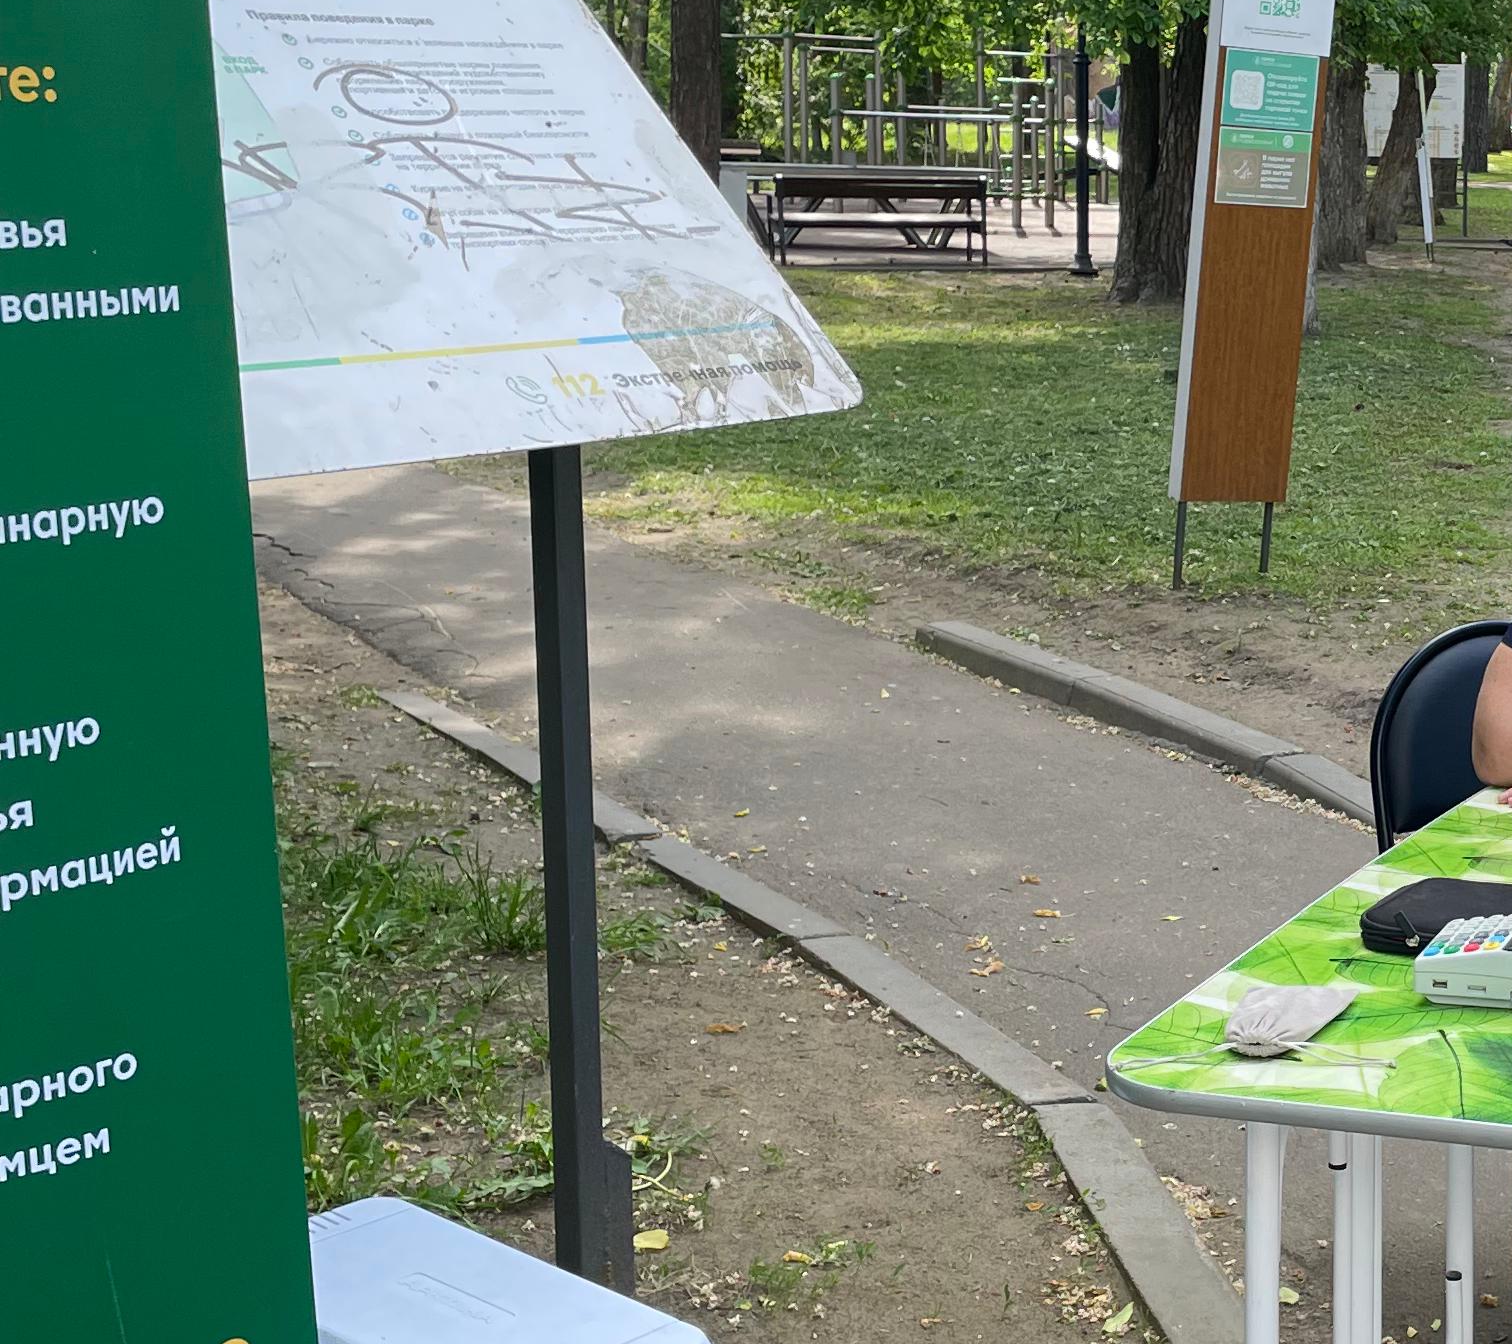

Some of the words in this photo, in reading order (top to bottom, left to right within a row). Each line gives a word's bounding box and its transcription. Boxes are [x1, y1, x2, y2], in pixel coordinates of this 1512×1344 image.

[0, 218, 67, 249] вья
[0, 285, 180, 324] ванными
[552, 373, 606, 399] 112
[728, 359, 803, 377] помощь
[0, 825, 182, 911] рмацией
[0, 1128, 111, 1182] мцем
